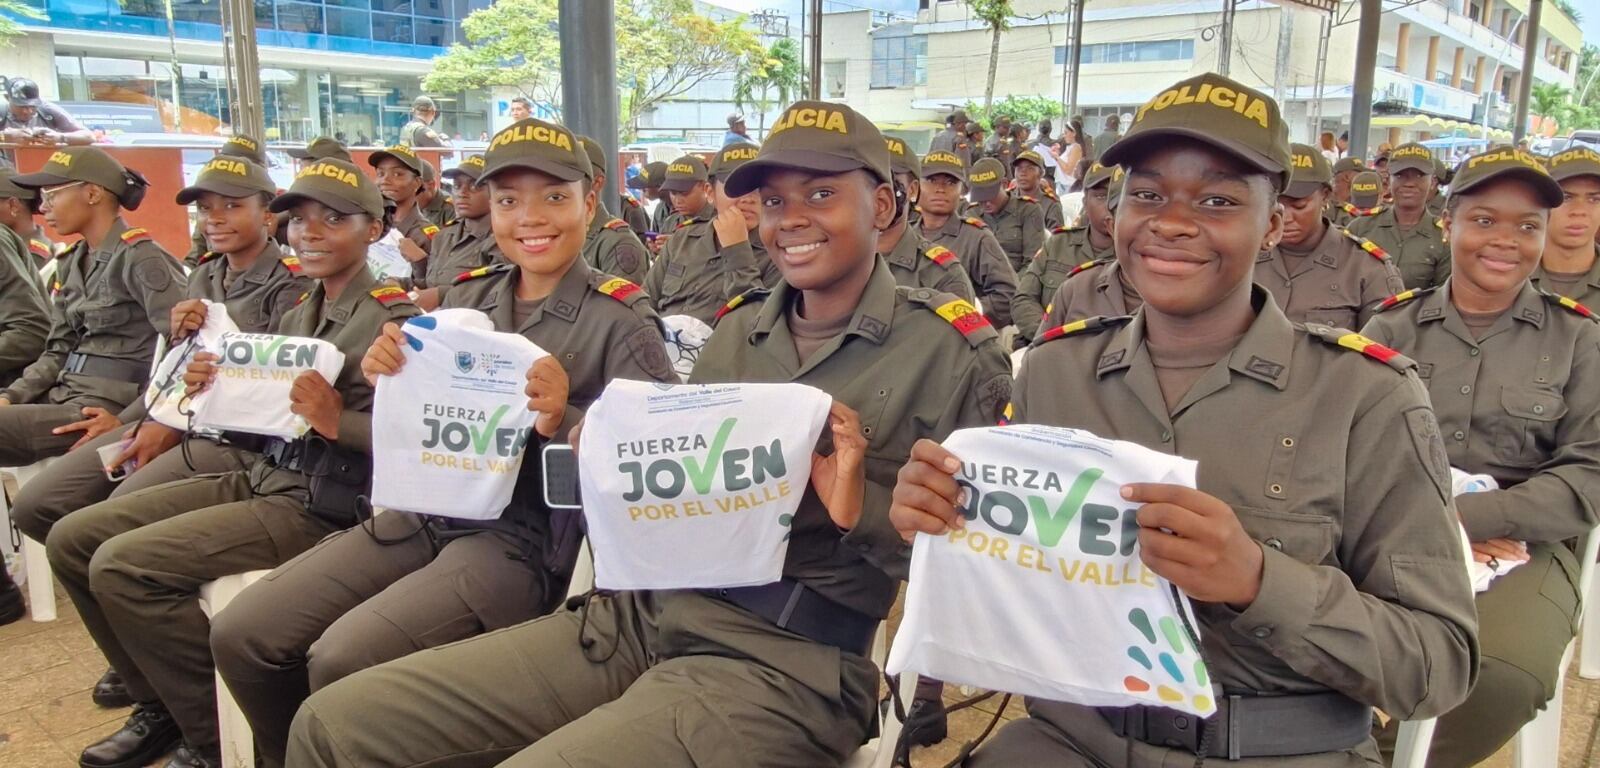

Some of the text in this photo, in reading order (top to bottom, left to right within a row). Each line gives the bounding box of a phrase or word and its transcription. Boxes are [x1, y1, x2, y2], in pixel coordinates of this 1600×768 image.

[1136, 83, 1268, 128] POLICIA
[772, 108, 848, 134] LICIA
[489, 126, 572, 152] POLICIA
[723, 148, 759, 162] POLIC
[924, 153, 962, 168] POLICIA
[1551, 149, 1600, 167] POLIC
[423, 403, 487, 422] FUERZA
[421, 404, 533, 457] JOVEN
[617, 434, 707, 458] FUERZA
[421, 452, 457, 468] POR
[462, 457, 482, 471] EL
[618, 417, 787, 502] JOVEN
[960, 461, 1063, 493] UERZA
[628, 480, 792, 521] POR EL VALLE
[948, 527, 1156, 588] POR EL VALLE
